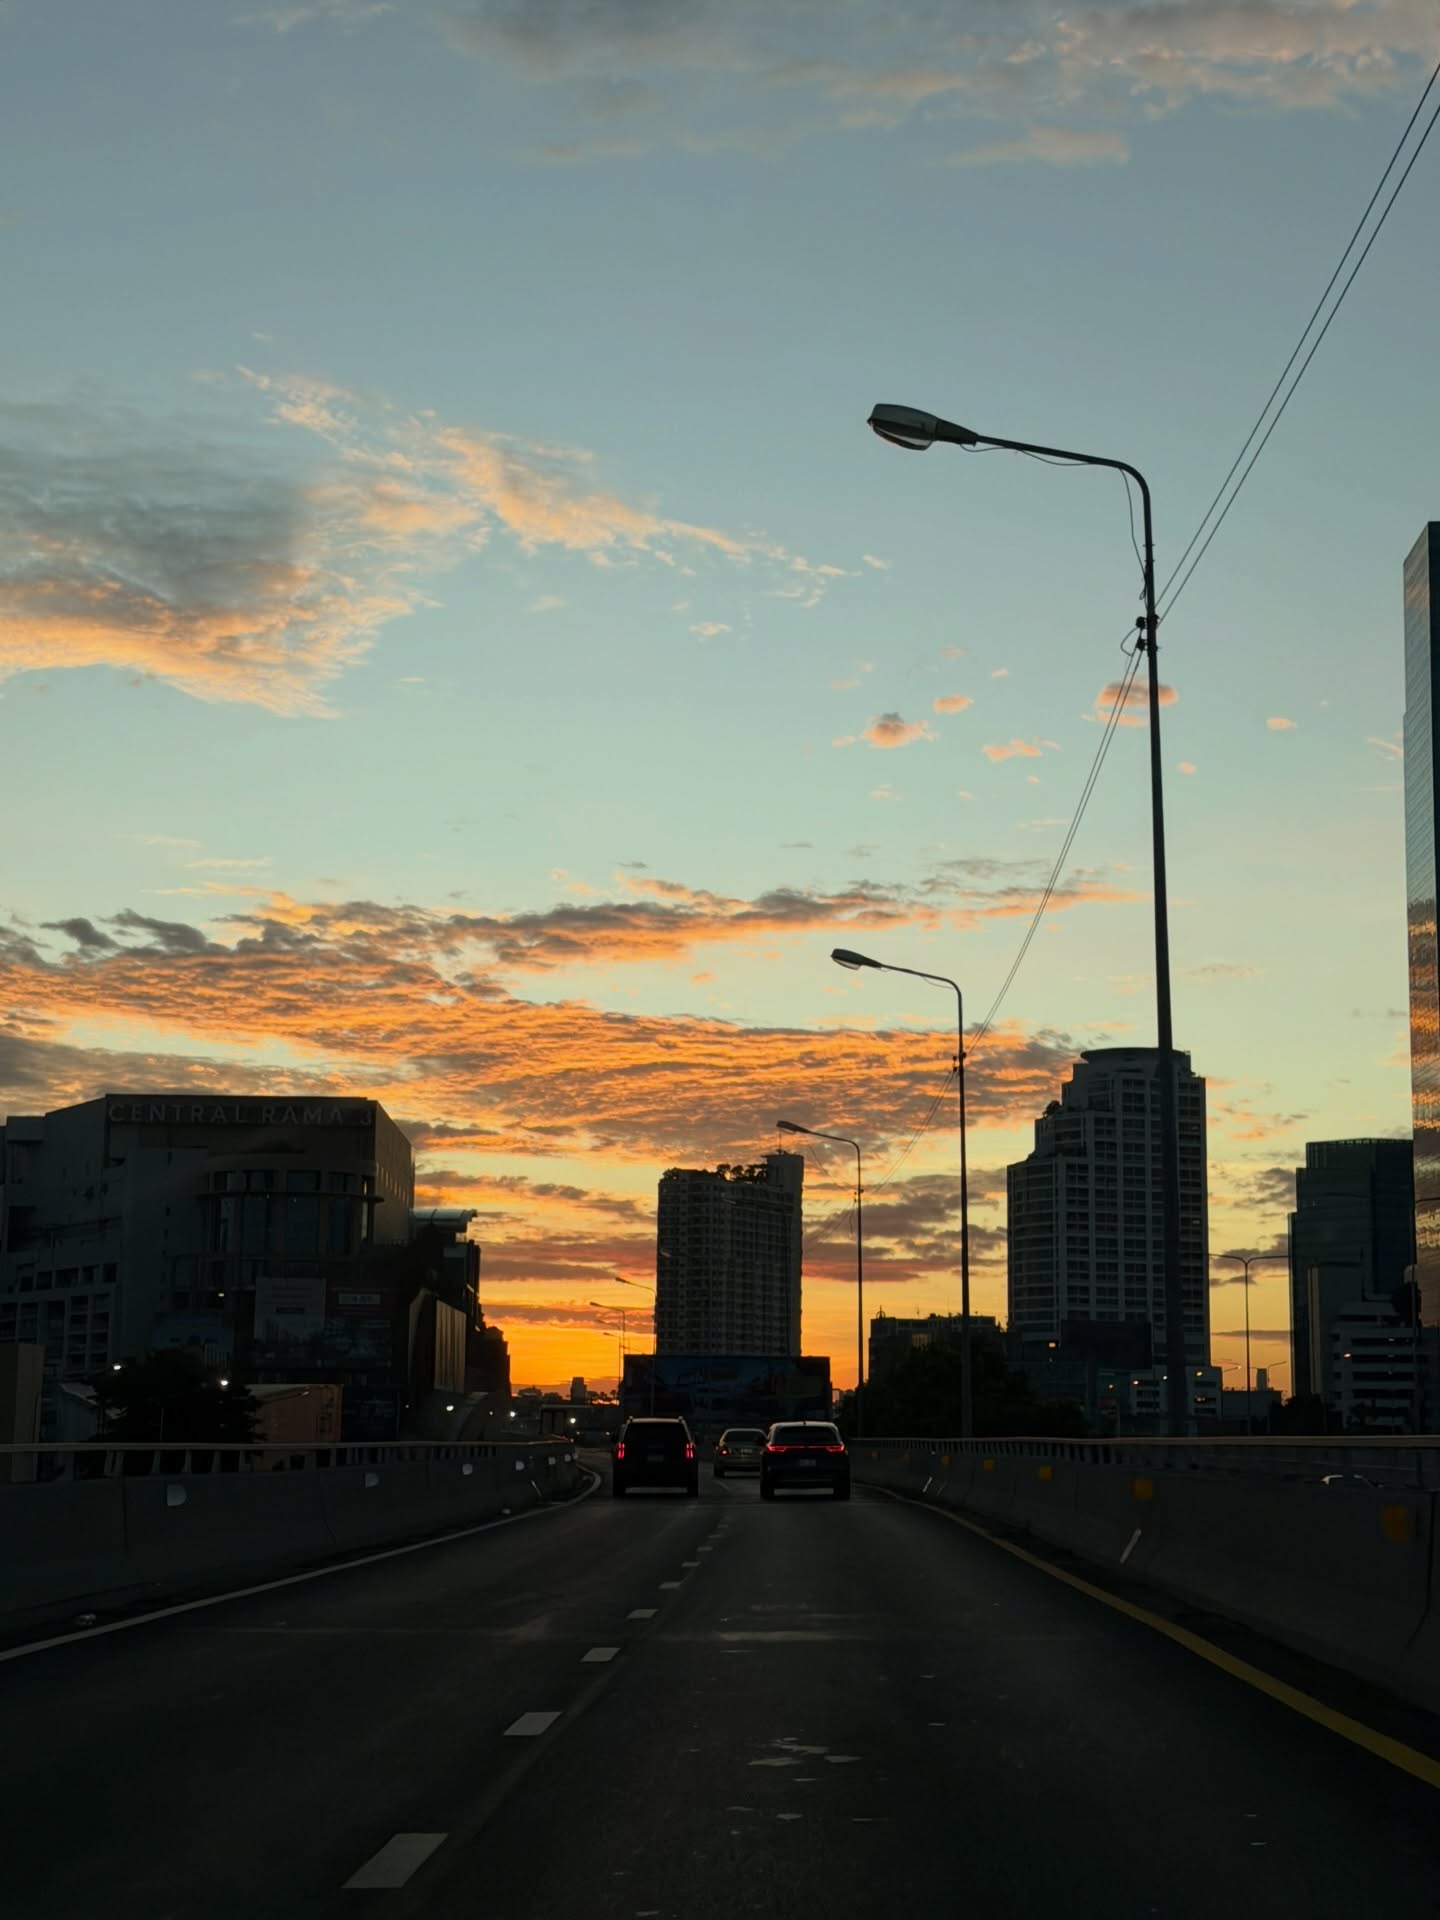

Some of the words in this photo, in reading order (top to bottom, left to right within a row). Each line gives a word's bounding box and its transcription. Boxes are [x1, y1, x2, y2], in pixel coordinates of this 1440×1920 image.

[108, 1103, 246, 1122] CENTRAL
[262, 1105, 344, 1124] RAMA
[359, 1106, 372, 1126] 3
